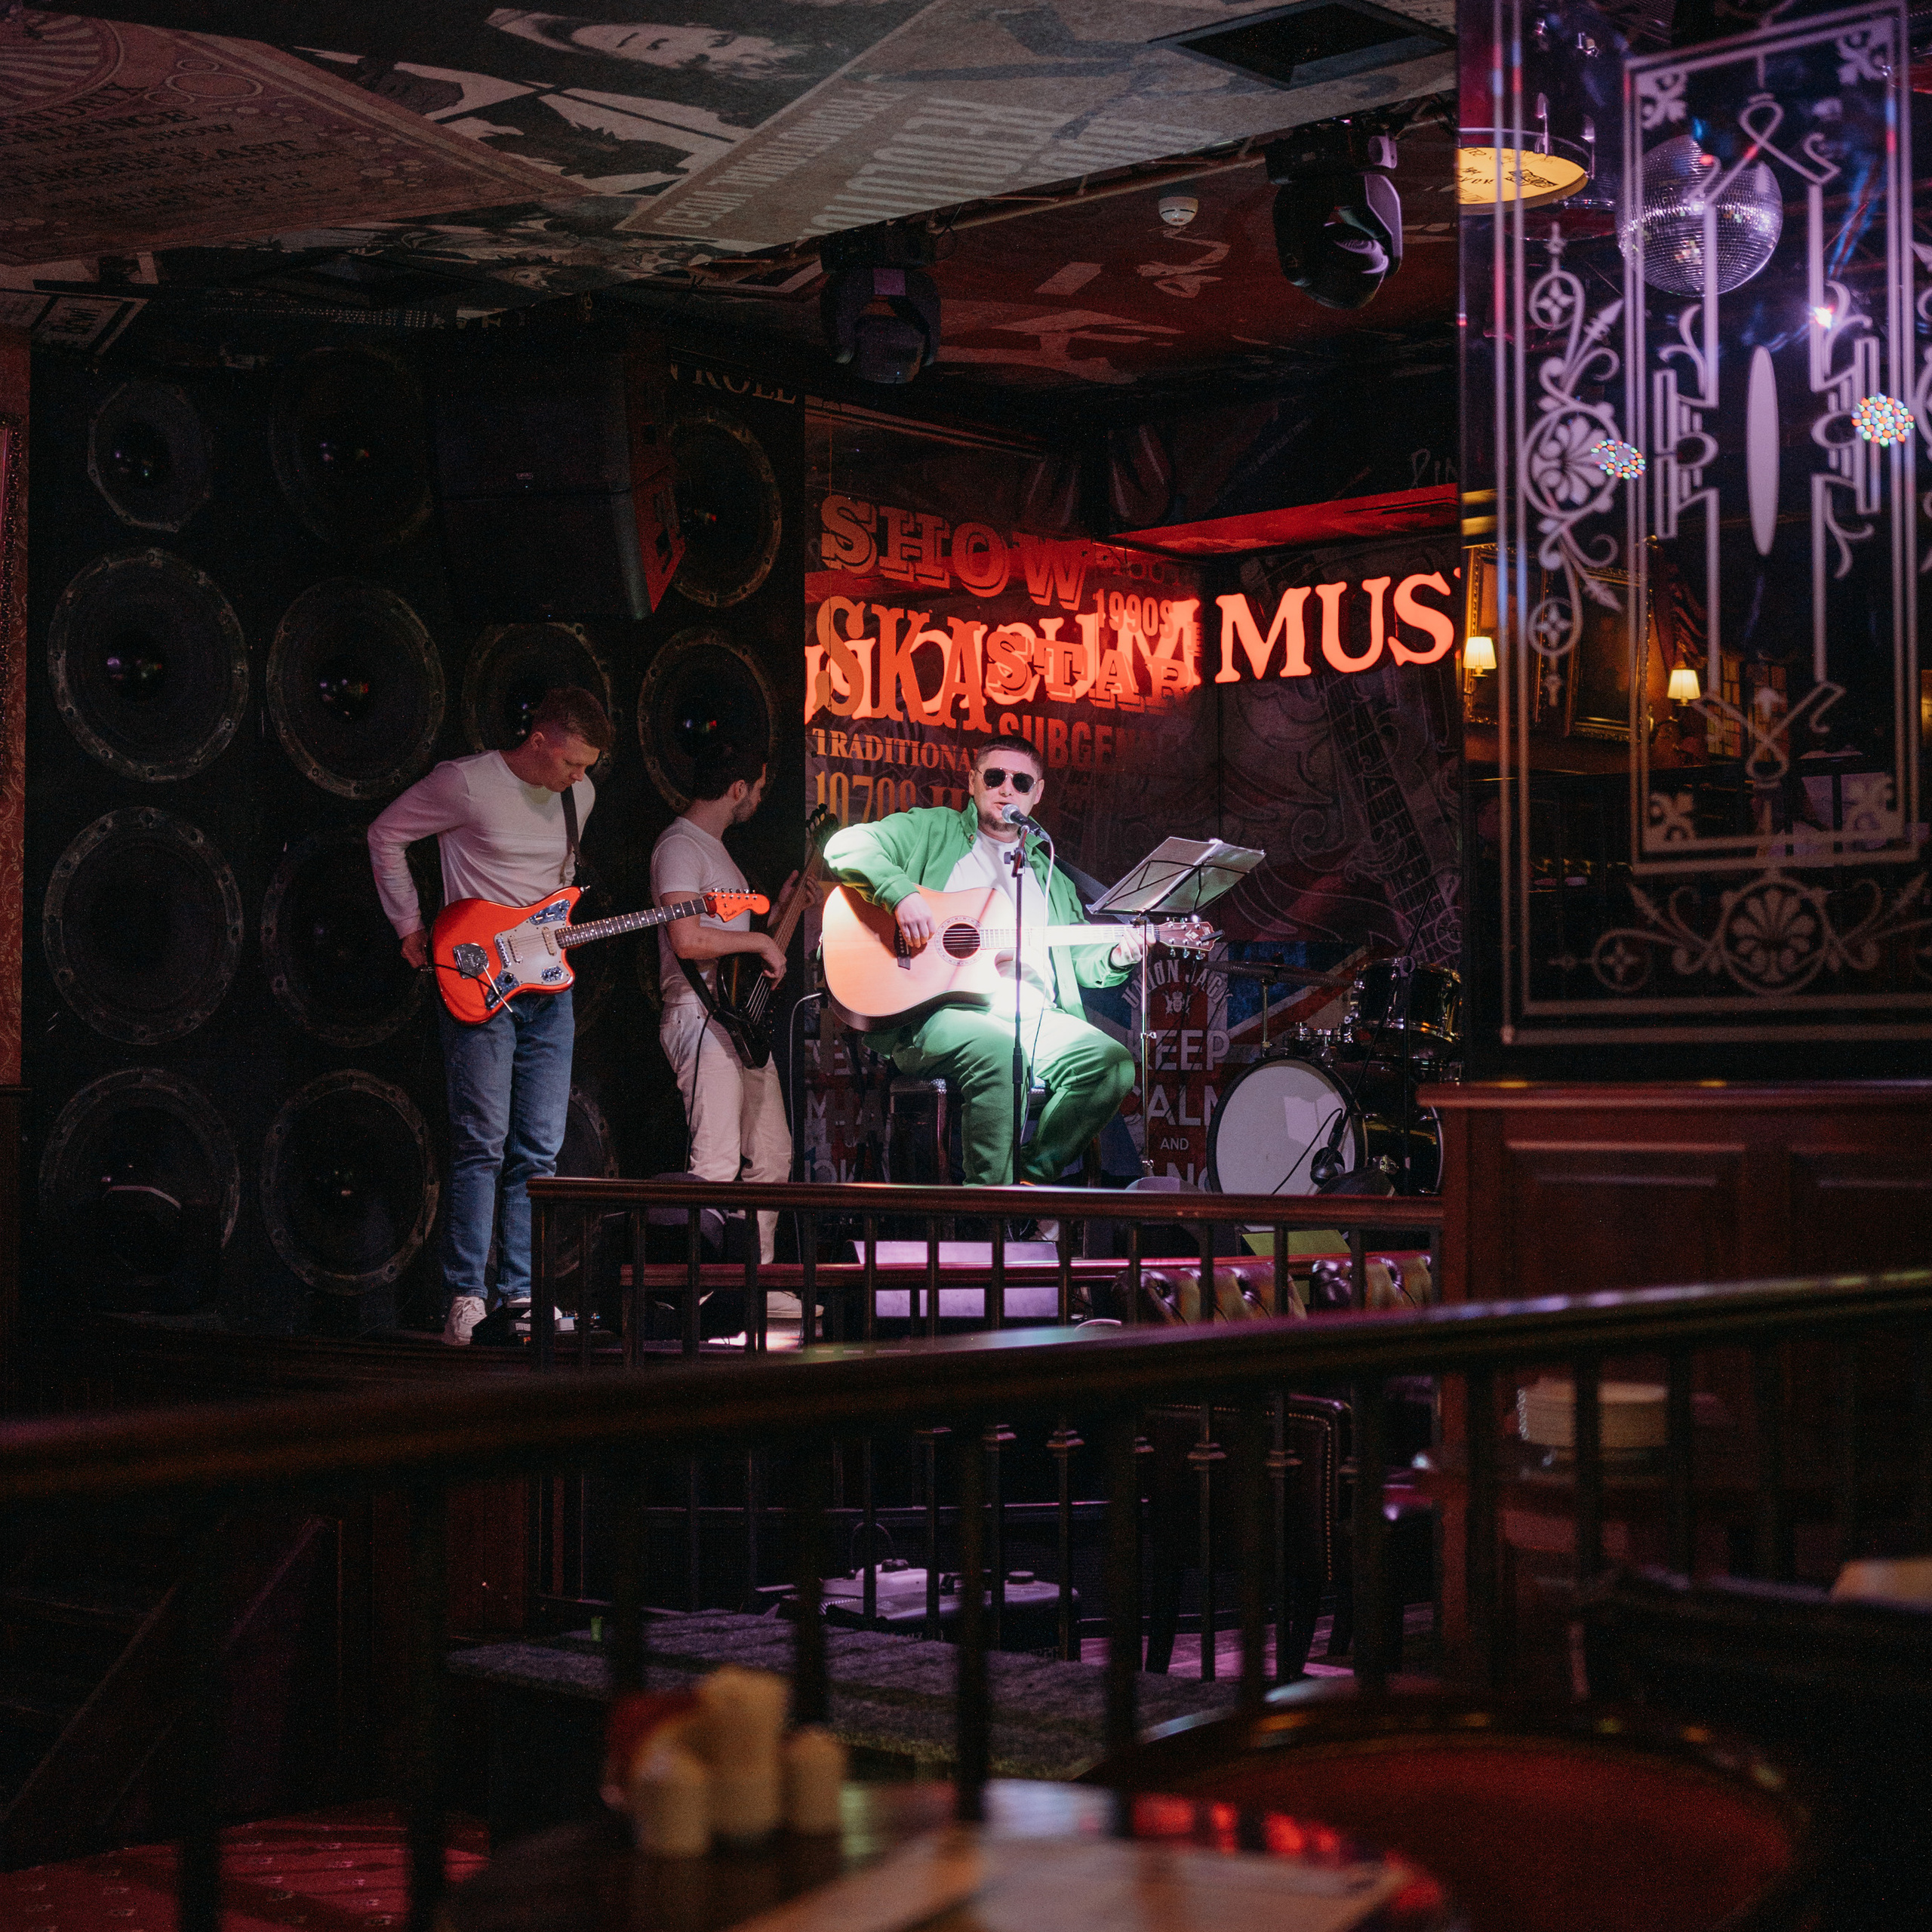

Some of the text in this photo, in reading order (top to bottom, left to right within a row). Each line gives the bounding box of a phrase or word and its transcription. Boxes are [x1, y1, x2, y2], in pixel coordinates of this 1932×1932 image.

[820, 494, 1097, 611] SHOW
[1214, 568, 1461, 684] MUS
[816, 595, 992, 734] SKA
[986, 631, 1197, 716] STAR
[812, 728, 980, 773] TRADITIONA
[1121, 959, 1180, 1009] UNION
[1128, 1029, 1230, 1071] KEEP
[1160, 1137, 1189, 1151] AND
